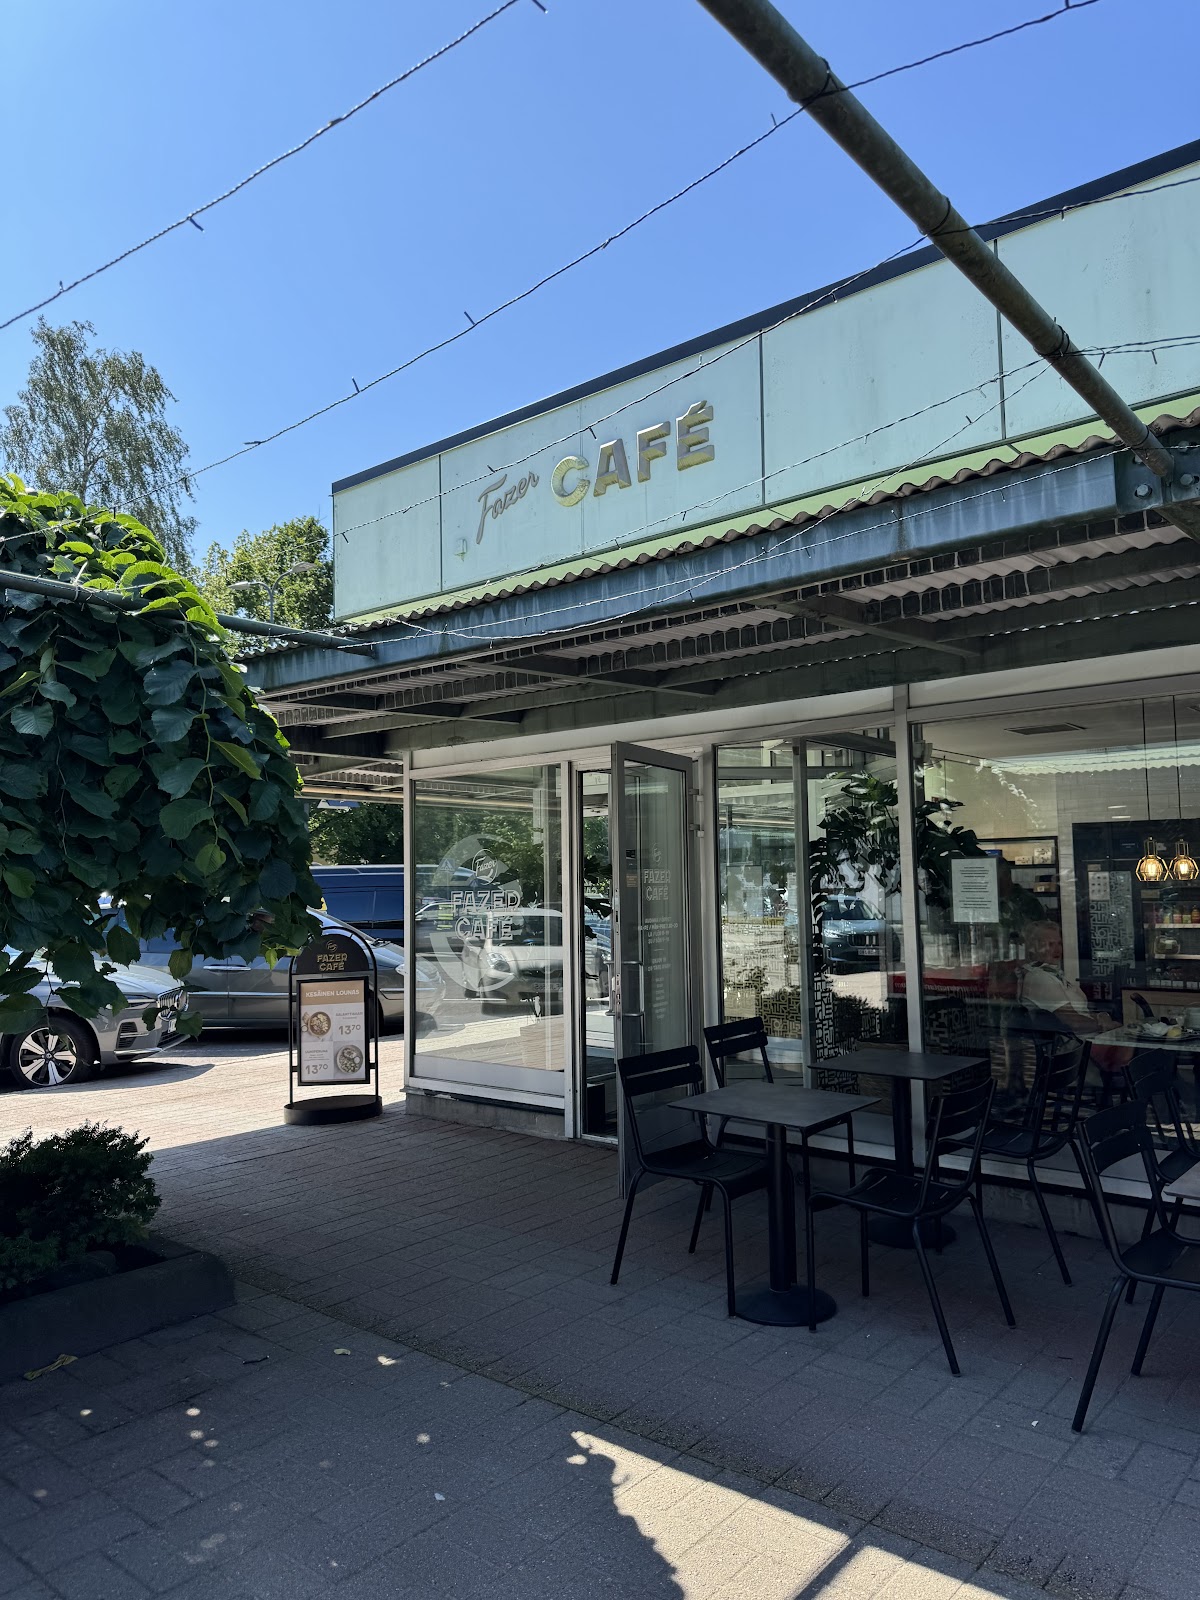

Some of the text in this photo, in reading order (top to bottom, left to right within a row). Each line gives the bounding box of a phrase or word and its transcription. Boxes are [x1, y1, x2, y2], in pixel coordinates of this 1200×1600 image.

[476, 400, 716, 545] Fazer CAFÉ
[317, 953, 348, 963] FAZER
[319, 962, 345, 971] CAFÉ
[305, 989, 335, 998] KESÄINEN
